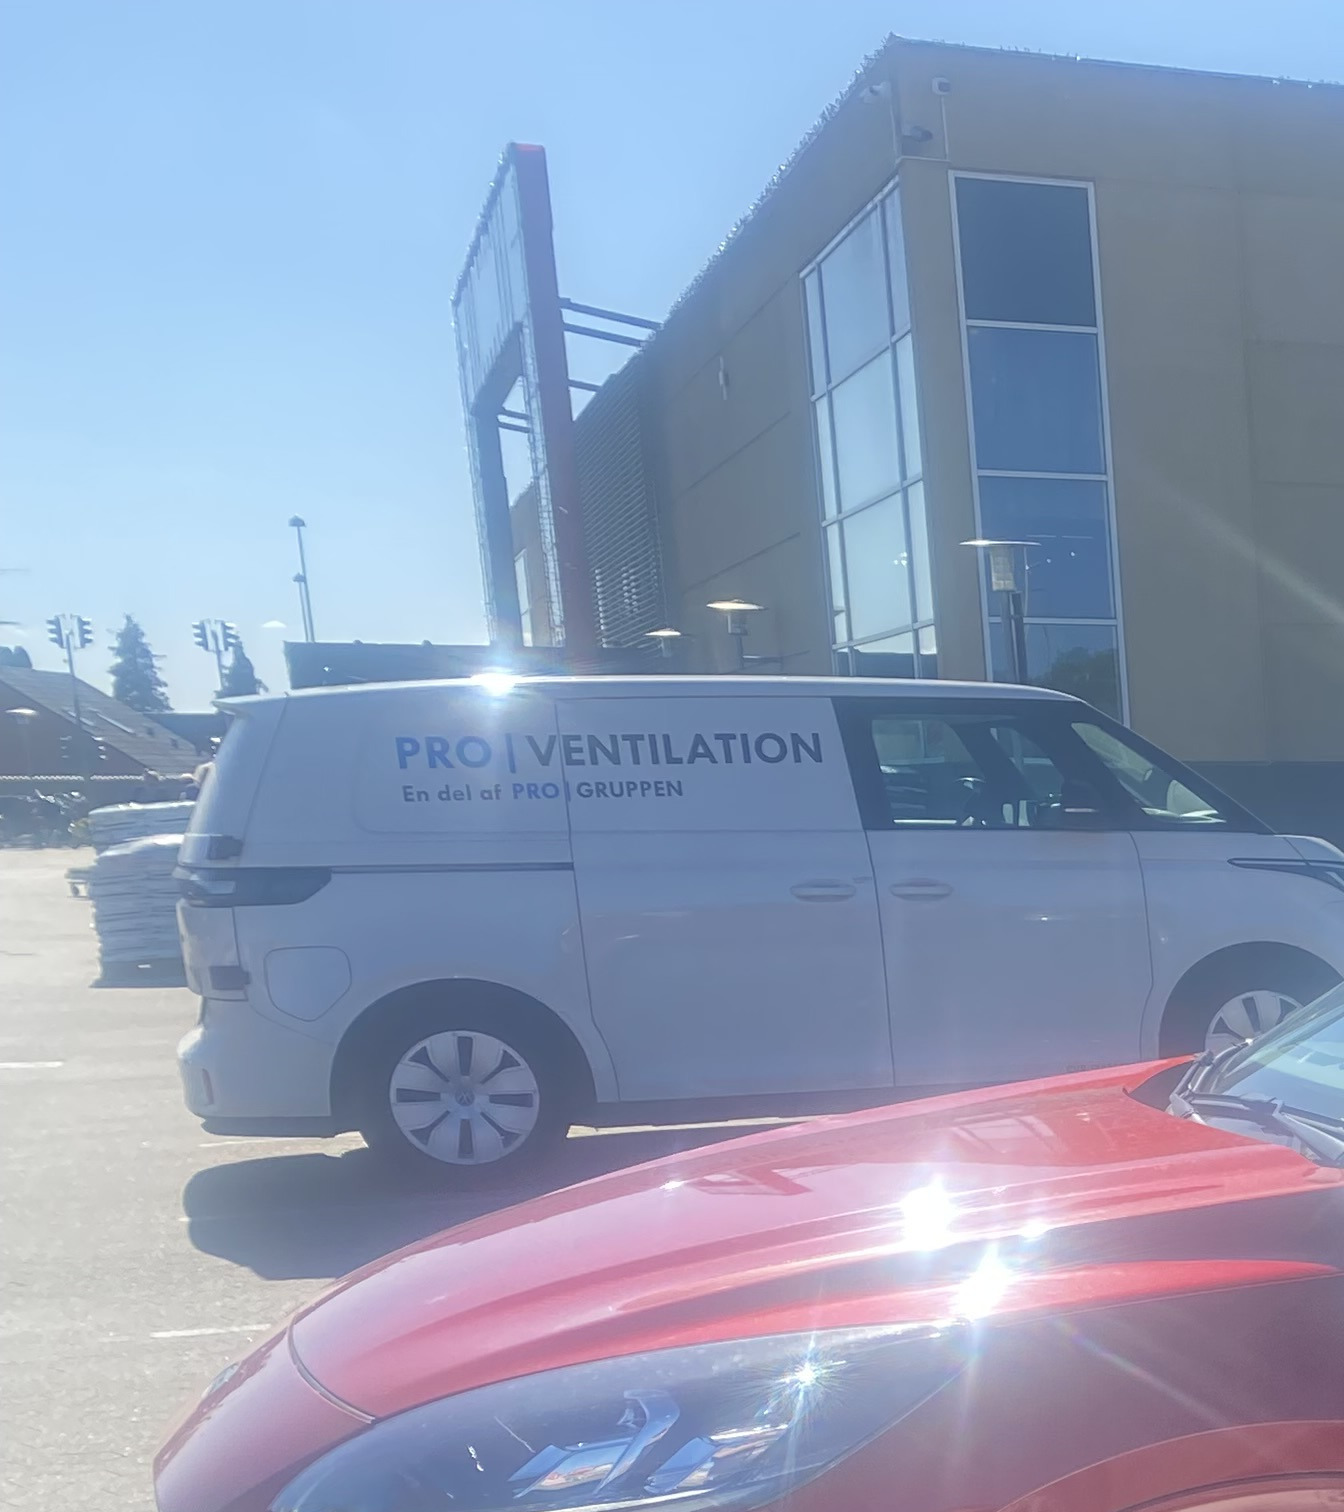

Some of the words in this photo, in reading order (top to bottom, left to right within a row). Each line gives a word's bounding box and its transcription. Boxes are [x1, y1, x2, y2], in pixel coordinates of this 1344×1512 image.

[395, 735, 492, 769] PRO
[525, 733, 823, 766] VENTILATION
[402, 785, 429, 802] En
[437, 784, 472, 801] del
[480, 784, 502, 800] af
[512, 783, 560, 799] PRO
[576, 780, 683, 798] GRUPPEN
